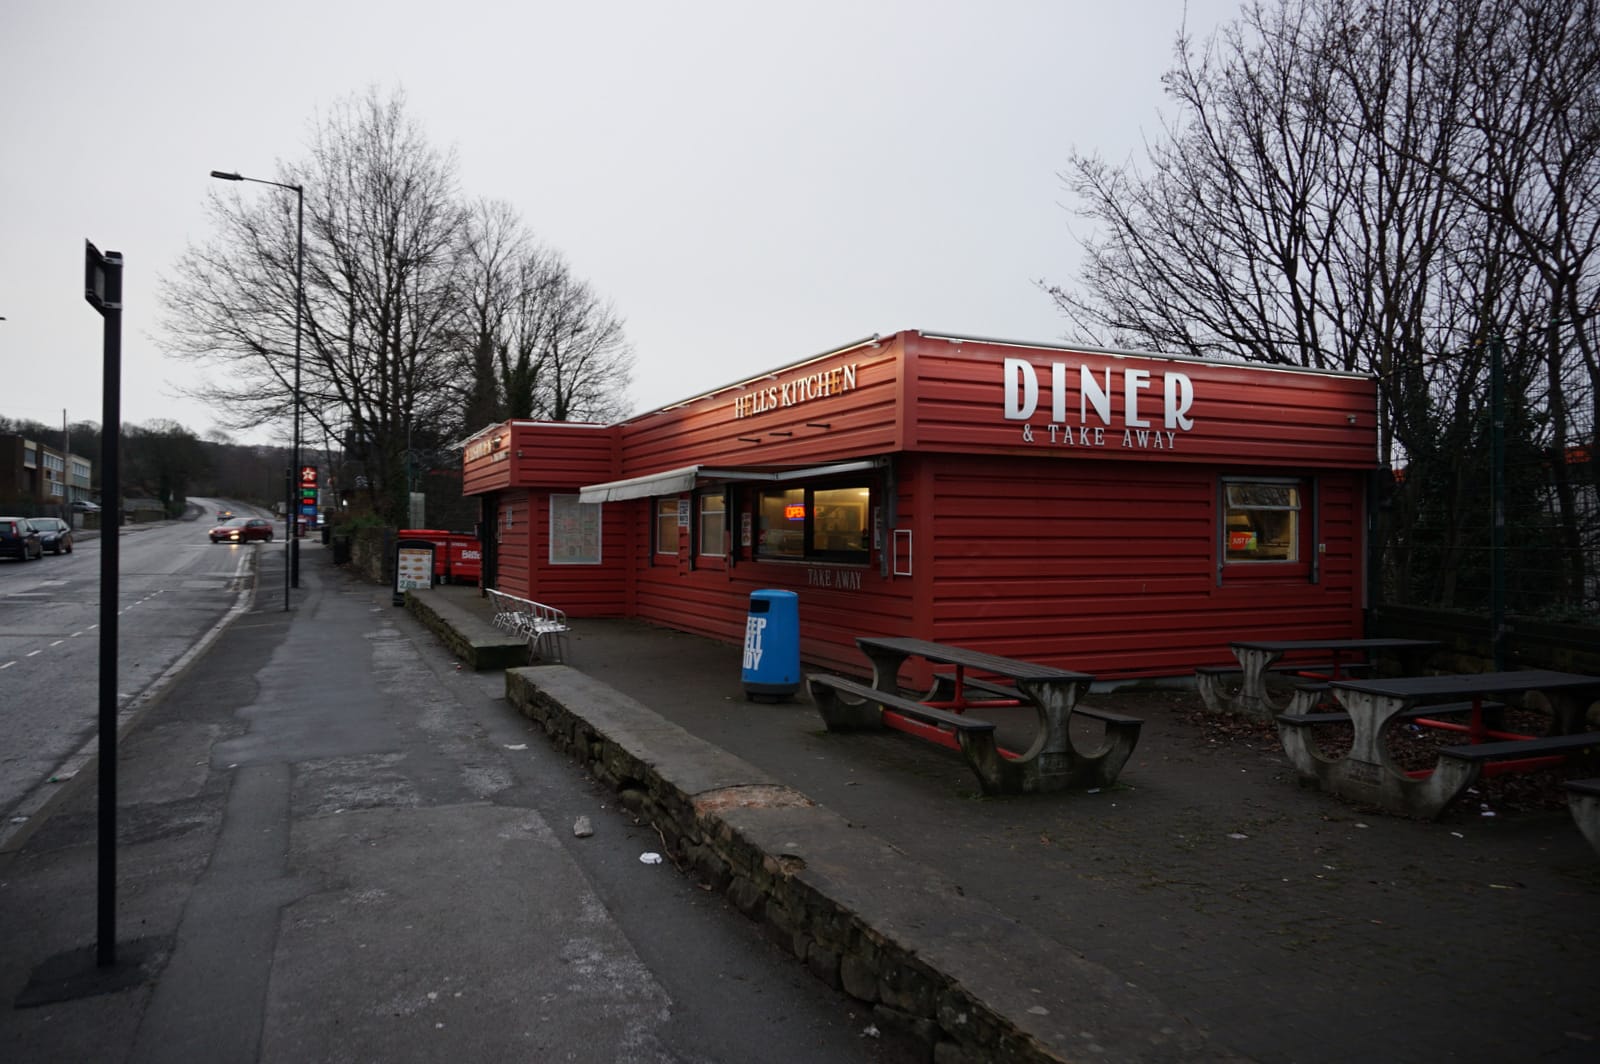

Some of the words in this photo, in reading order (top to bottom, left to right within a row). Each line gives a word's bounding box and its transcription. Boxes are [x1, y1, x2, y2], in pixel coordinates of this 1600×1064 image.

[735, 386, 777, 418] HELL'S
[781, 364, 857, 406] KITCHEN
[1004, 357, 1194, 431] DINER
[1022, 423, 1035, 443] &
[1048, 425, 1105, 446] TAKE
[1122, 429, 1176, 449] AWAY
[808, 568, 832, 587] TAKE
[835, 570, 862, 590] AWAY
[747, 616, 767, 635] EEP
[742, 649, 763, 670] IDY
